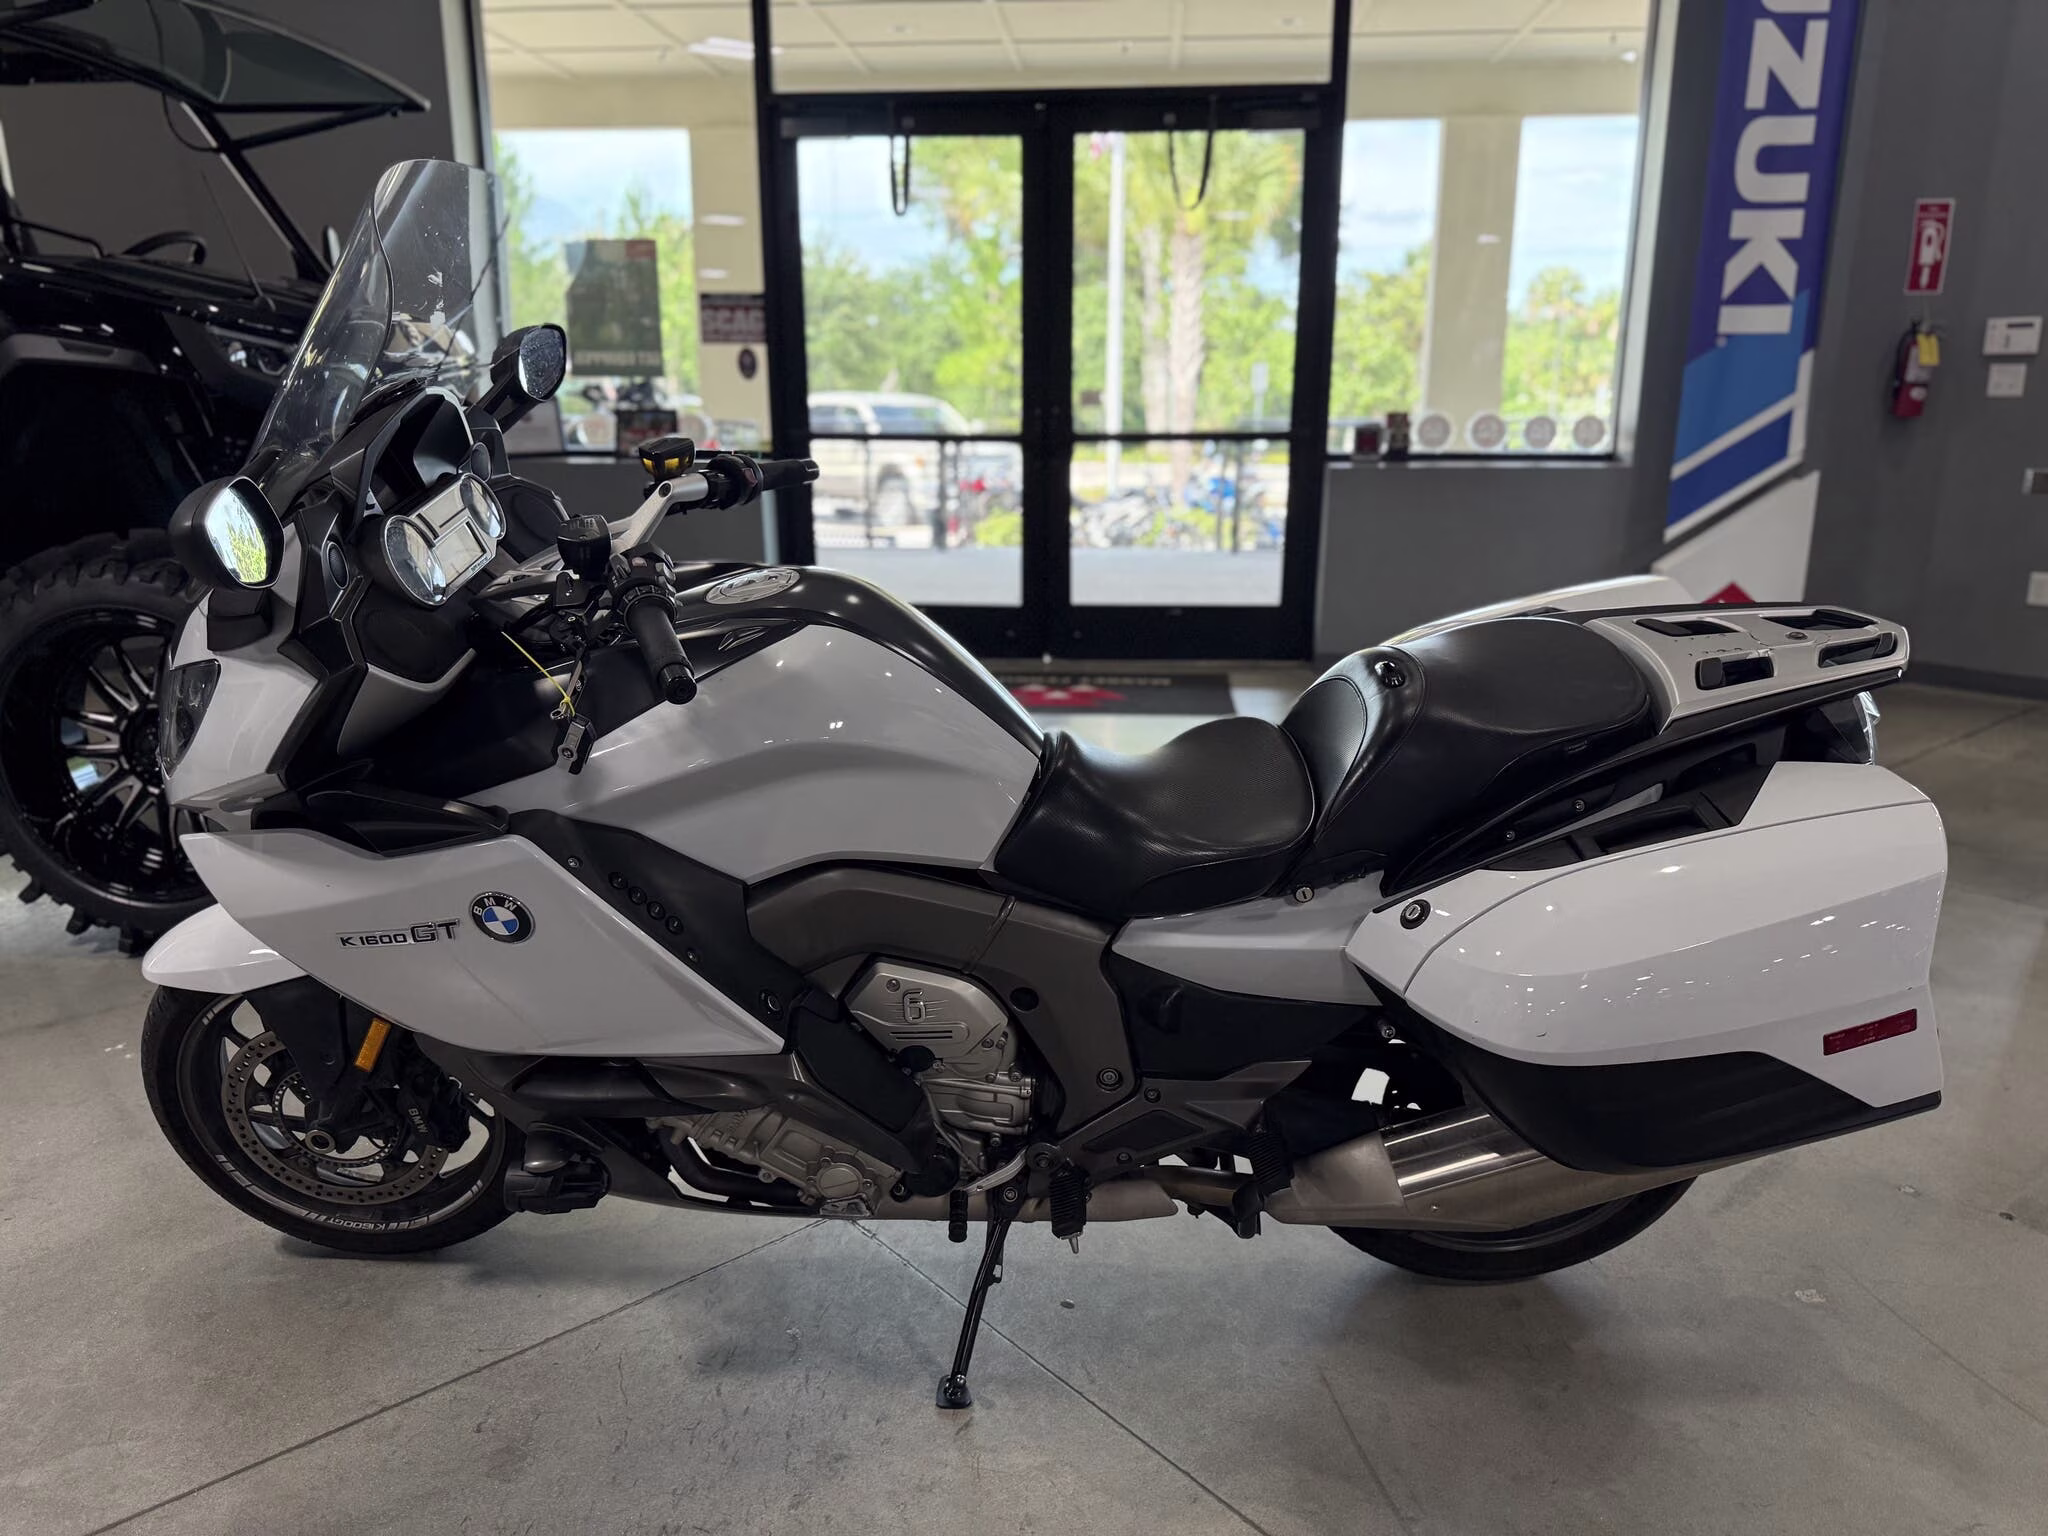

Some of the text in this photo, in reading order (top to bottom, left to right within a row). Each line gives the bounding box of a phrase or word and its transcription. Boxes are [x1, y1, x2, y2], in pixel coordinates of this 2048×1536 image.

[1717, 0, 1831, 335] ZUKI
[473, 897, 517, 915] BMW
[903, 988, 926, 1024] 6
[408, 1107, 428, 1134] BMW
